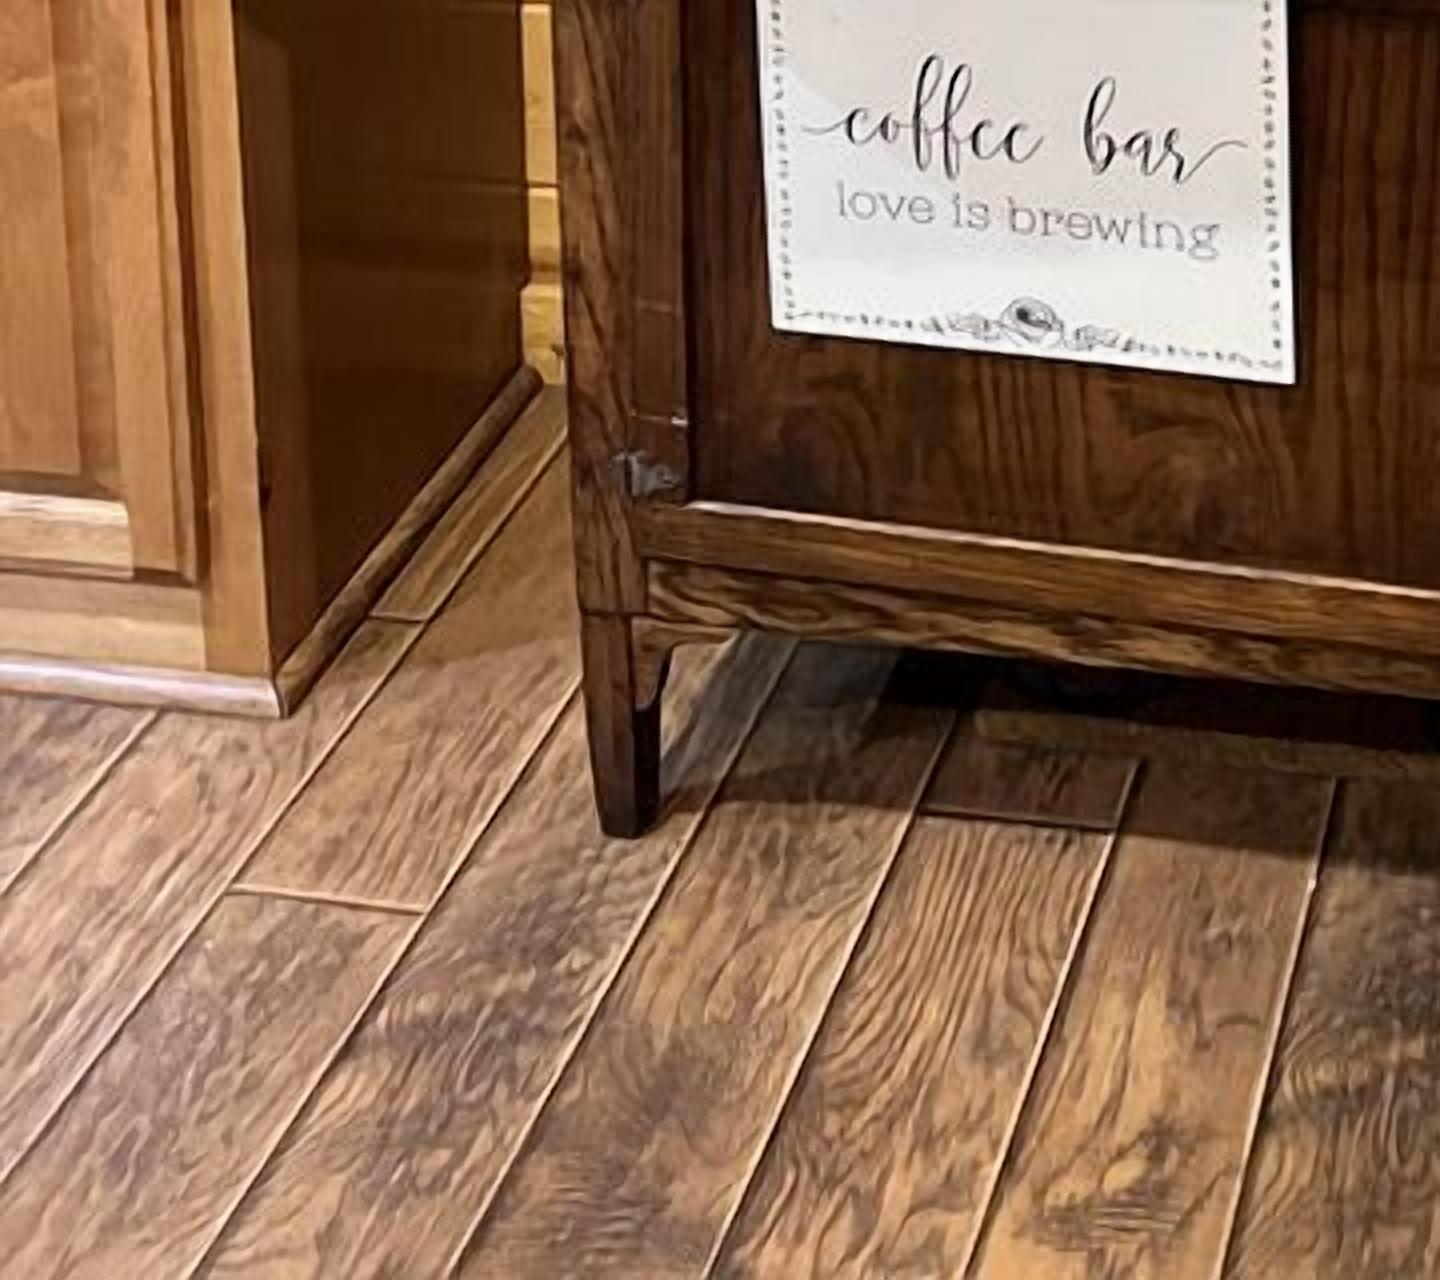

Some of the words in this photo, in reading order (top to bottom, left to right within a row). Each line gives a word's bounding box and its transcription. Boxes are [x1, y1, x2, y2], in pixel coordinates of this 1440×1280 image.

[800, 53, 1045, 181] coffee
[1083, 76, 1248, 185] bar
[837, 180, 935, 225] love
[953, 192, 991, 231] is
[1007, 195, 1222, 261] brewing
